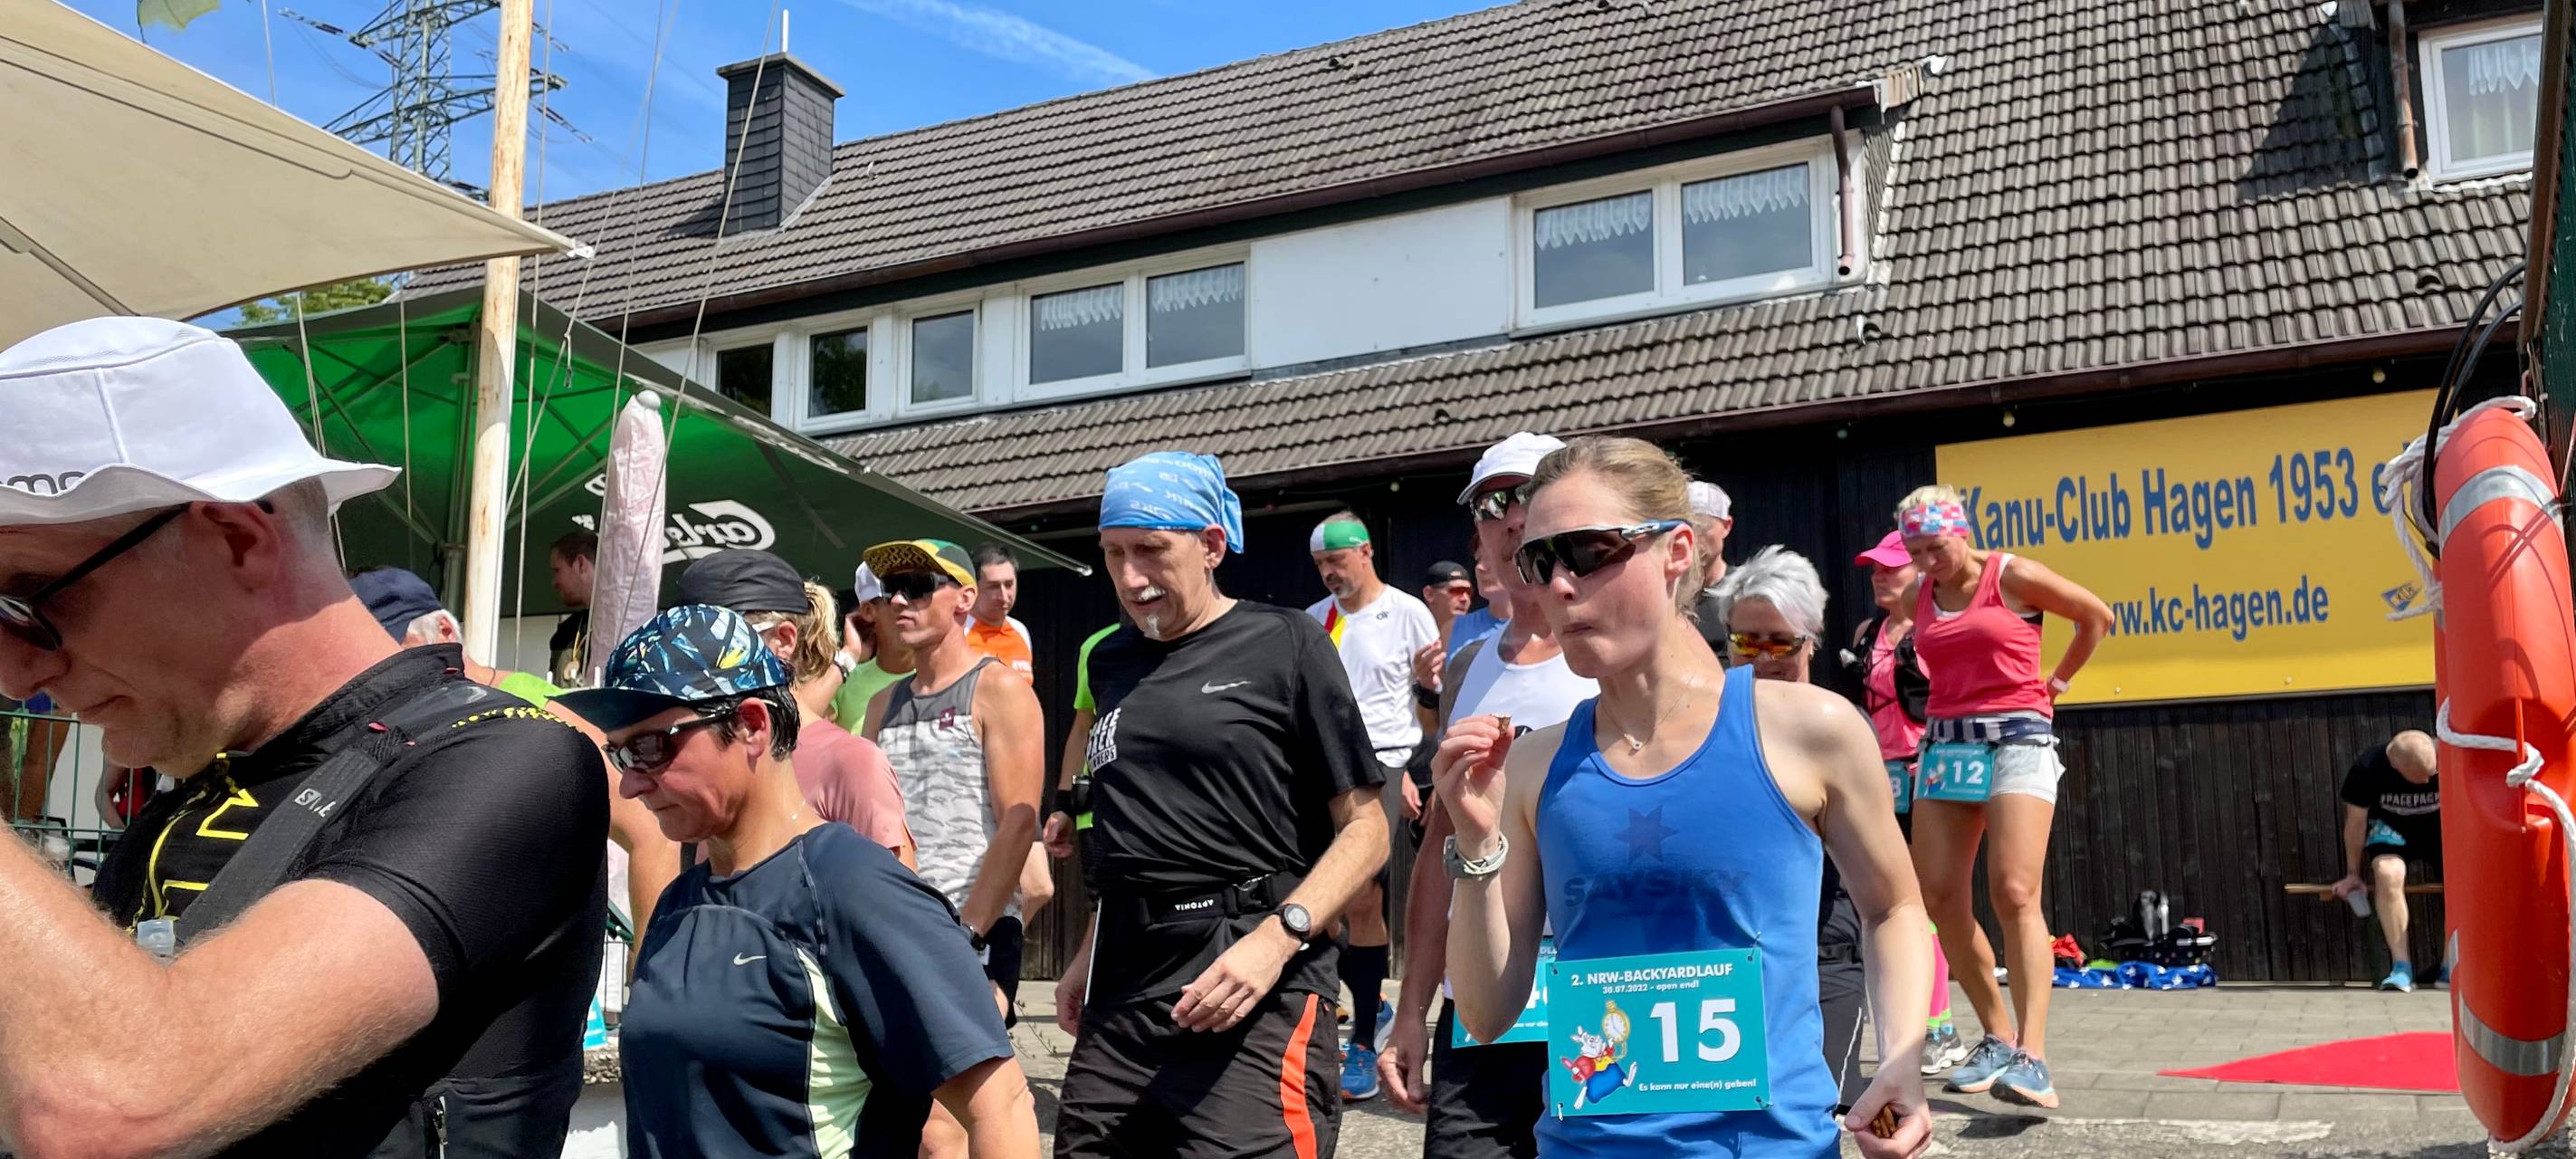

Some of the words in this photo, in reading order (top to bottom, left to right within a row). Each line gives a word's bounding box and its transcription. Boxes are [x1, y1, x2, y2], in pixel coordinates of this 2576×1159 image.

[1961, 470, 2131, 551] Kanu-Club
[2142, 467, 2256, 550] Hagen
[2269, 447, 2358, 524] 1953
[2110, 574, 2329, 642] w.kc-hagen.de
[1952, 760, 1985, 785] 12
[1174, 898, 1215, 911] APTONIA
[1571, 974, 1583, 986] 2.
[1587, 963, 1733, 985] NRW-BACKYARDLAUF
[1602, 983, 1648, 994] 30.07.2022
[1656, 983, 1678, 991] open
[1680, 980, 1699, 989] end!
[1649, 998, 1741, 1063] 15
[1638, 1083, 1648, 1091] Es
[1650, 1083, 1672, 1091] kann
[1691, 1080, 1722, 1090] eine(n)
[1724, 1078, 1756, 1090] geben!
